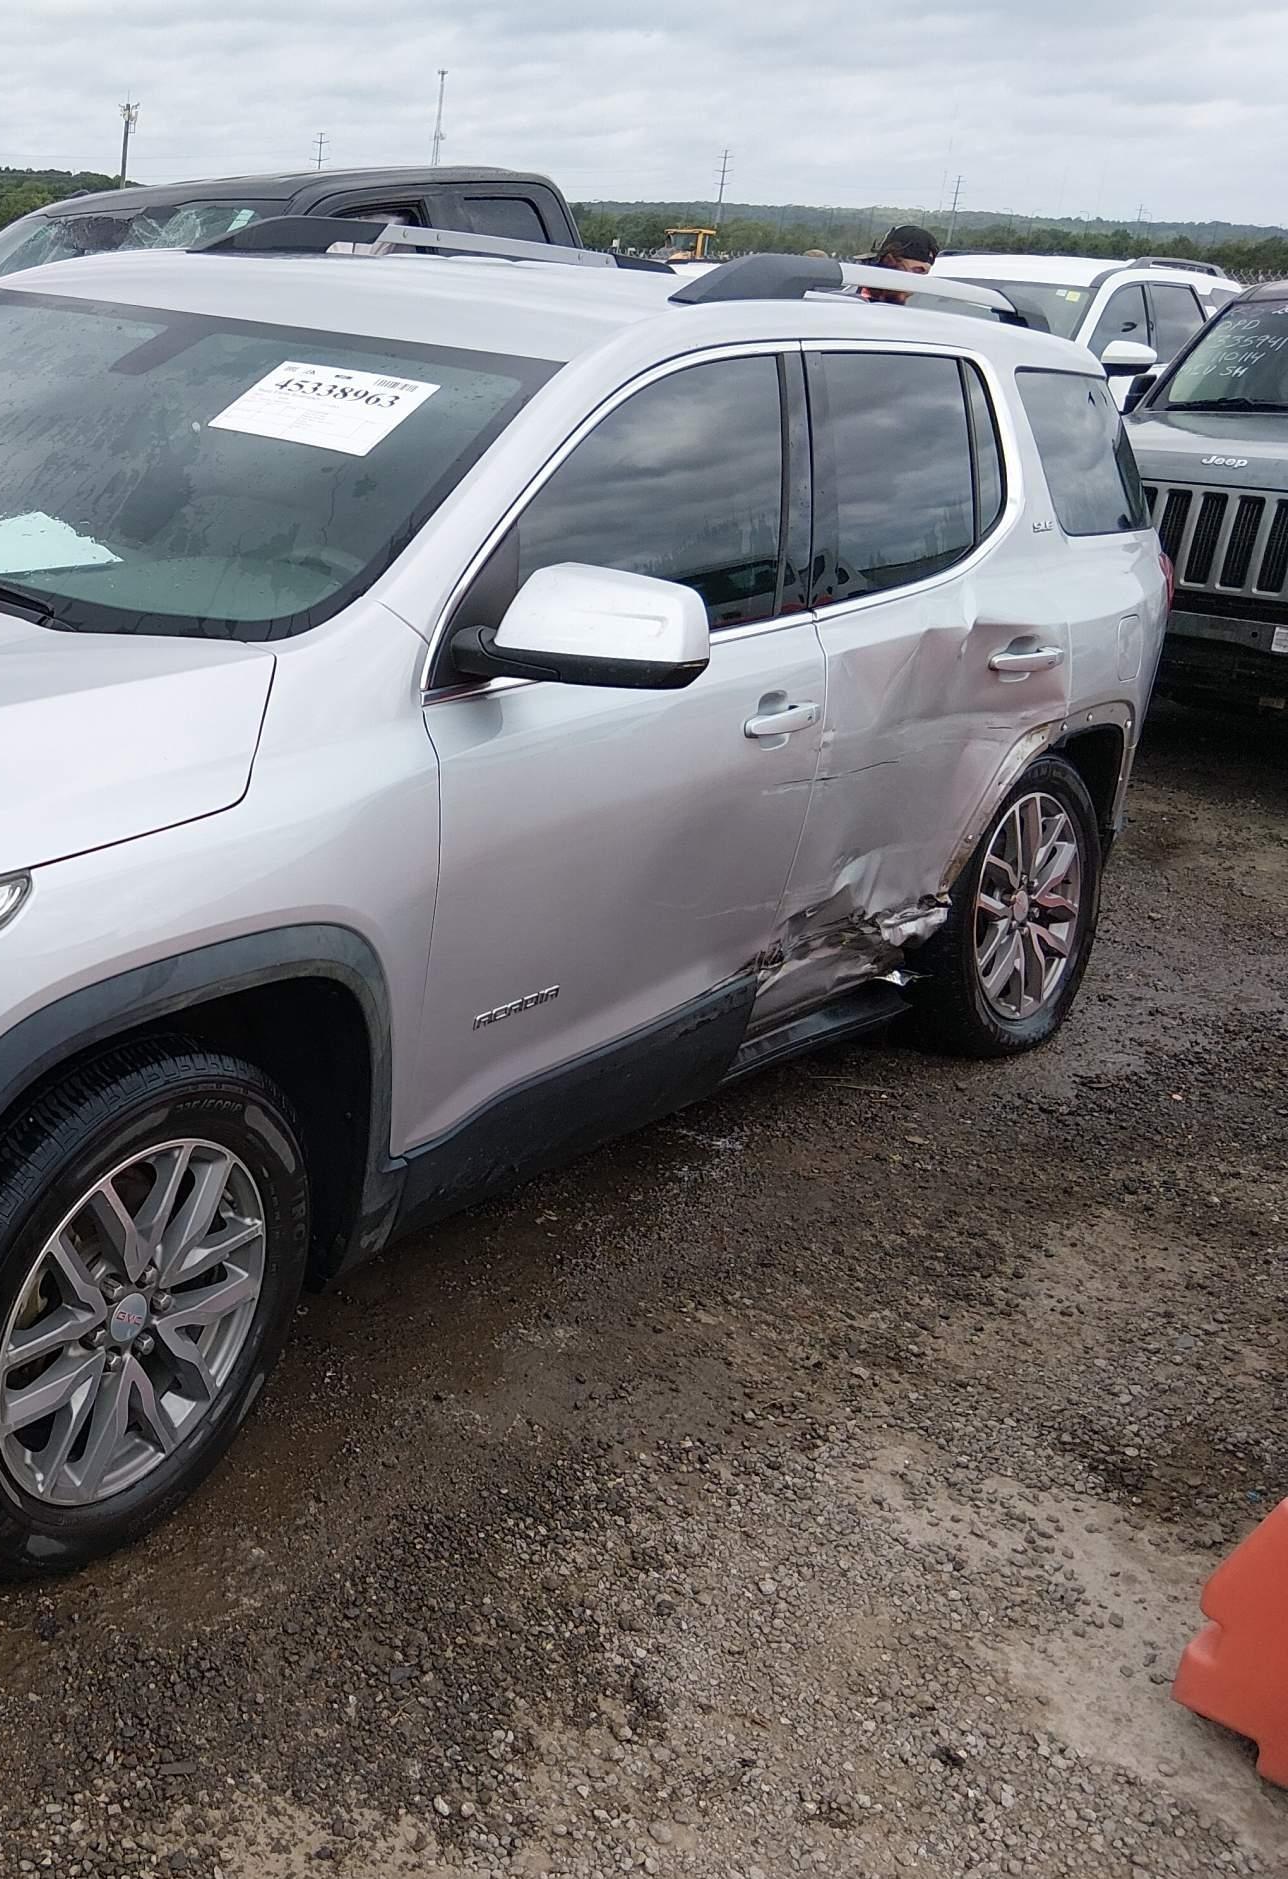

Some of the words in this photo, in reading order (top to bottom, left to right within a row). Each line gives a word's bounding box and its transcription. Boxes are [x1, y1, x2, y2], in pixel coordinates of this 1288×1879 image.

[274, 377, 401, 409] 45338963
[1201, 455, 1248, 469] Jeep
[472, 984, 560, 1031] ACADIA
[115, 1310, 144, 1326] GMC
